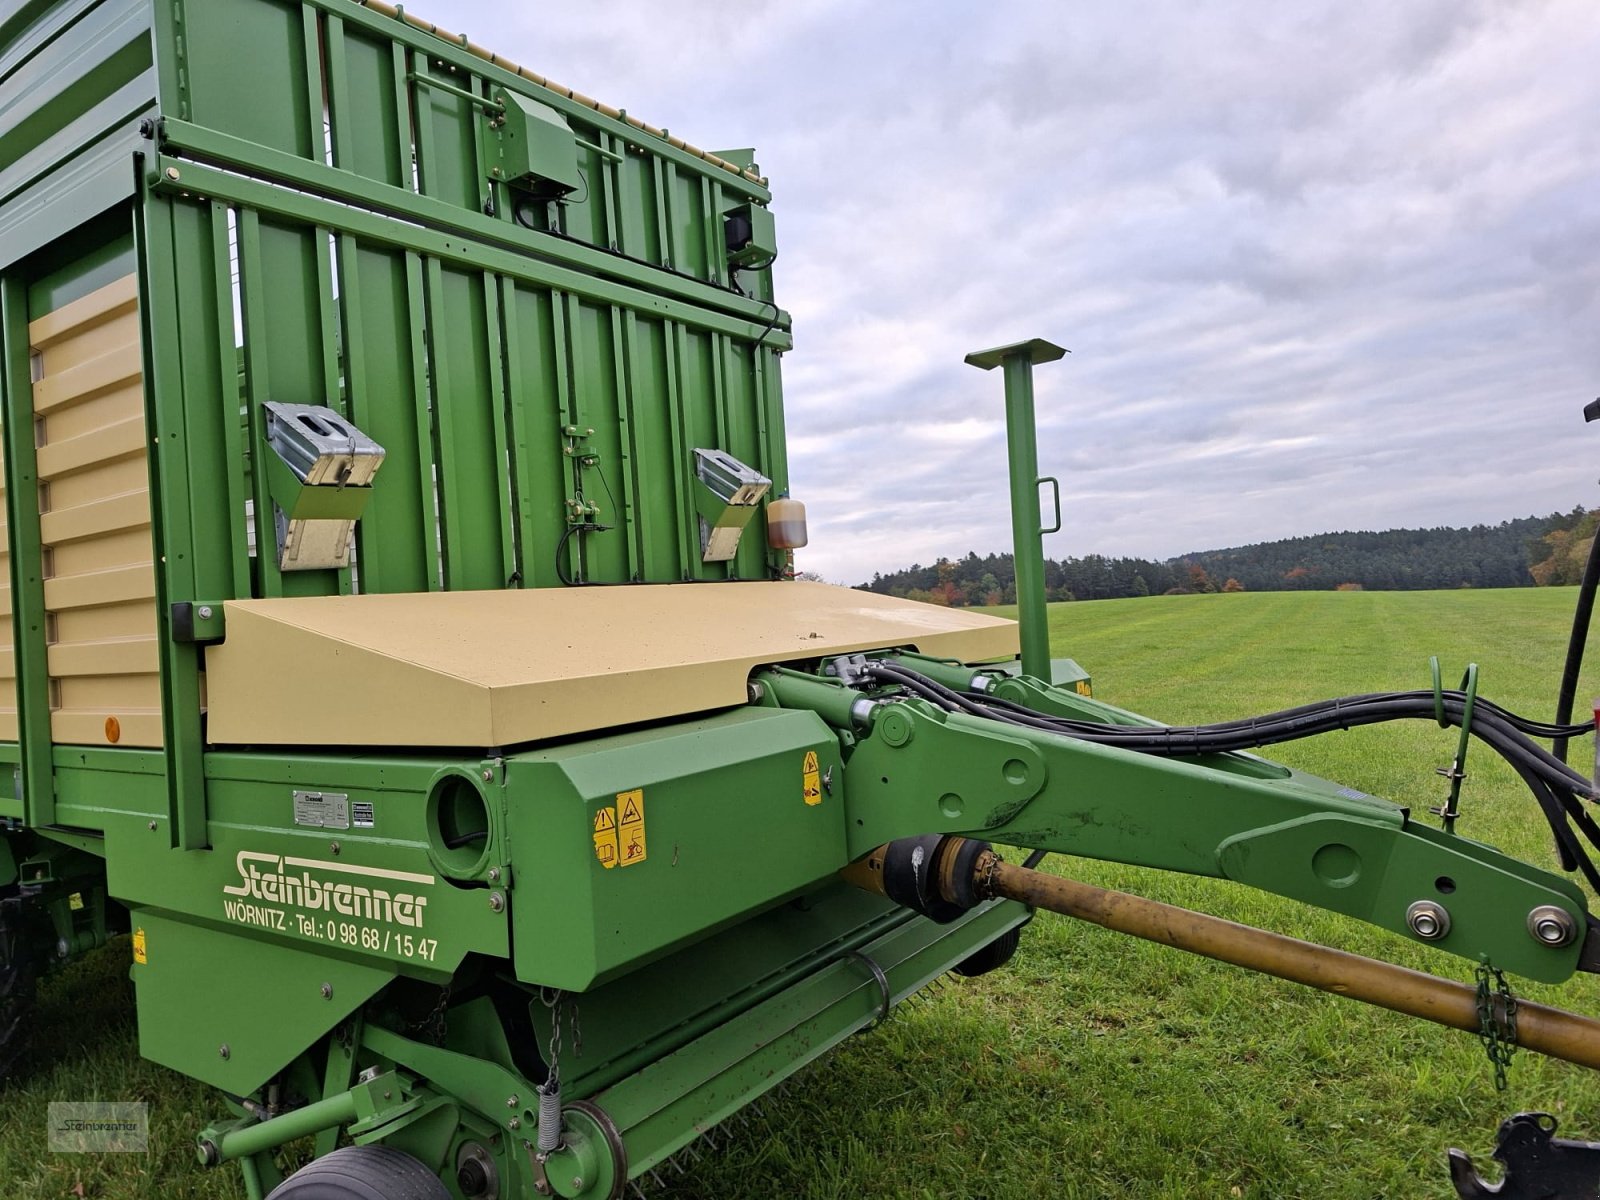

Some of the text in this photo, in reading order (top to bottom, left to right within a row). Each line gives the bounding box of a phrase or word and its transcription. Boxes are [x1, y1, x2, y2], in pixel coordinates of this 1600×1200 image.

[223, 850, 430, 928] Steinbrenner
[224, 899, 286, 931] WÖRNITZ
[296, 914, 323, 939] Tel.:
[327, 920, 336, 941] 0
[340, 923, 357, 946] 98
[361, 927, 380, 950] 68
[394, 933, 414, 957] 15
[418, 938, 438, 962] 47
